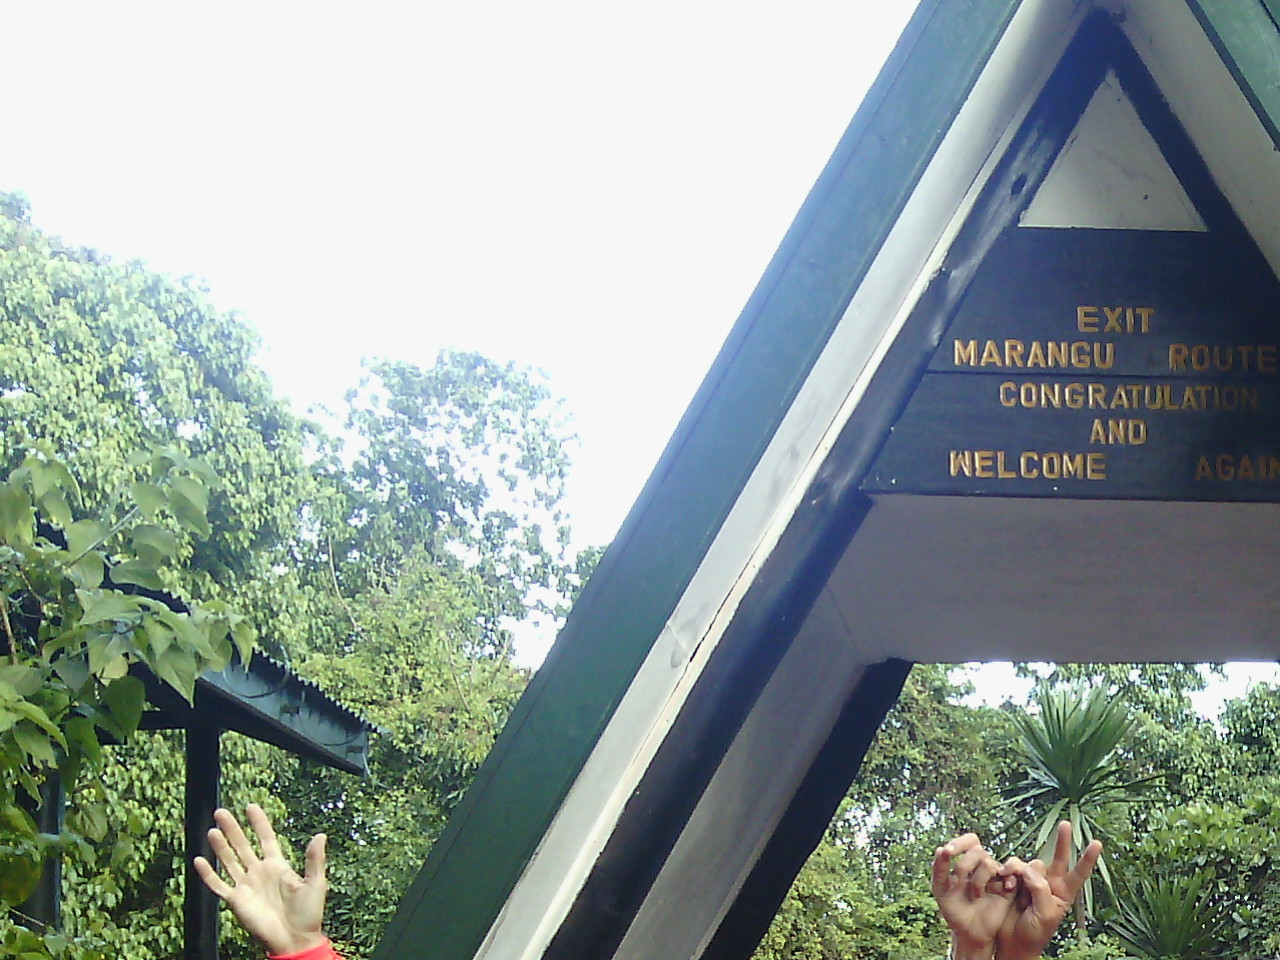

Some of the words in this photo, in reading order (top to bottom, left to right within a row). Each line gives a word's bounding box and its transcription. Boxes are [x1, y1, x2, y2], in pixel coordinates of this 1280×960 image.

[1077, 306, 1155, 334] EXIT
[953, 339, 1115, 368] MARANGU
[1168, 343, 1278, 373] ROUTE
[999, 381, 1259, 411] CONGRATULATION
[1090, 418, 1148, 445] AND
[949, 450, 1108, 480] WELCOME
